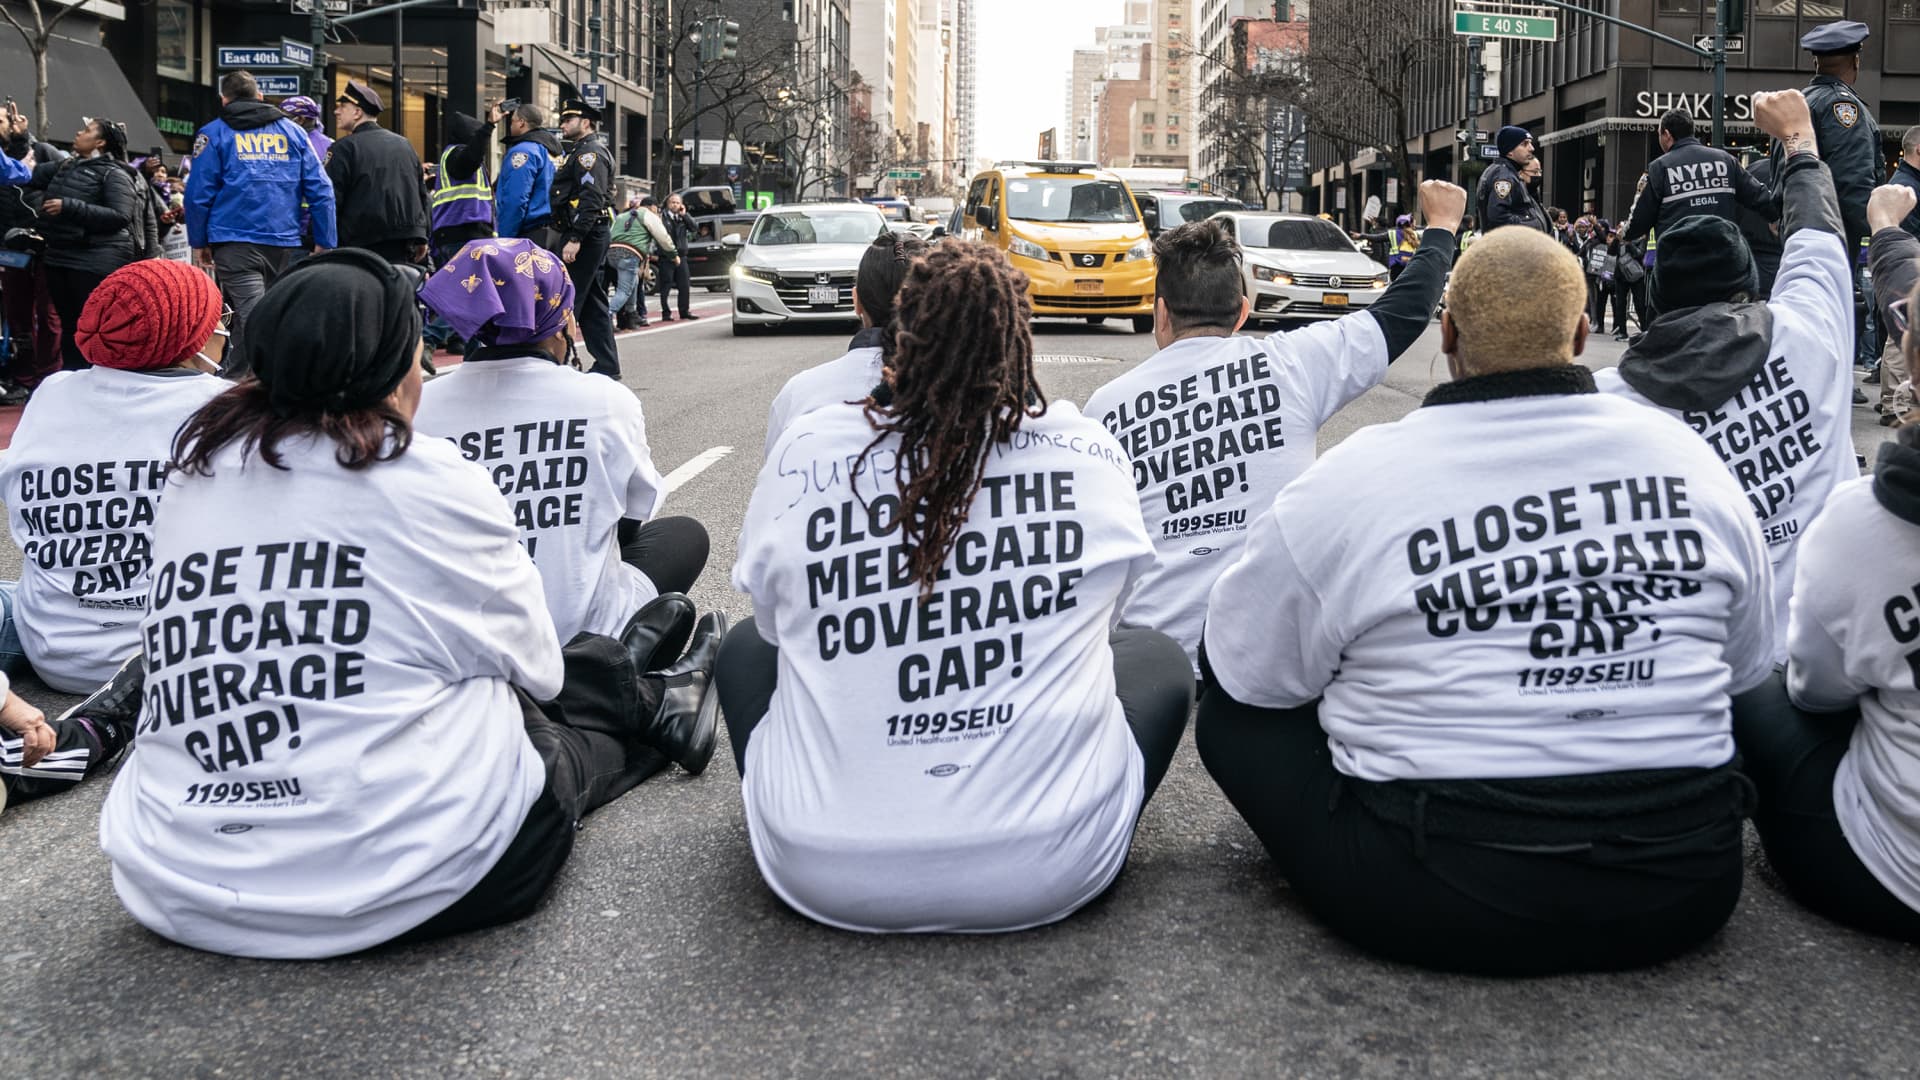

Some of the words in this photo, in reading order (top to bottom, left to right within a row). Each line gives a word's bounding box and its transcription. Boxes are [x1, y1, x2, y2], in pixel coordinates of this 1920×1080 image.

[1482, 18, 1490, 31] E
[1494, 19, 1511, 32] 40
[1515, 20, 1529, 34] St
[224, 52, 251, 64] East
[252, 52, 280, 64] 40th
[1636, 91, 1728, 119] SHAK
[235, 133, 289, 154] NYPD
[1608, 122, 1656, 132] BURGERS
[1667, 161, 1728, 185] NYPD
[1670, 177, 1729, 195] POLICE
[1690, 197, 1718, 207] LEGAL
[1102, 375, 1198, 435] CLOSE
[1204, 352, 1271, 394] THE
[513, 418, 588, 455] THE
[1706, 389, 1810, 463] ICAID
[1132, 417, 1284, 492] OVERAGE
[1732, 422, 1822, 492] RAGE
[21, 462, 116, 502] CLOSE
[124, 460, 168, 491] TH
[490, 455, 588, 496] CAID
[1165, 461, 1249, 514] GAP!
[21, 495, 161, 537] MEDICA
[806, 493, 930, 552] CLO
[981, 471, 1076, 518] THE
[1161, 509, 1247, 535] 1199SEIU
[1407, 486, 1581, 576] CLOSE
[1589, 476, 1691, 525] THE
[23, 533, 153, 570] COVERA
[1414, 529, 1706, 614] MEDICAID
[154, 546, 243, 611] OSE
[255, 541, 366, 591] THE
[817, 569, 1083, 662] COVERAGE
[148, 599, 371, 675] EDICAID
[898, 632, 1024, 704] GAP!
[1517, 659, 1655, 687] 1199SEIU
[145, 651, 365, 735] OVERAGE
[185, 704, 302, 774] GAP!
[887, 703, 1014, 736] 1199SEIU
[887, 737, 914, 747] United
[916, 734, 959, 745] Healthcare
[961, 729, 996, 741] Workers
[185, 777, 302, 804] 1199SEIU
